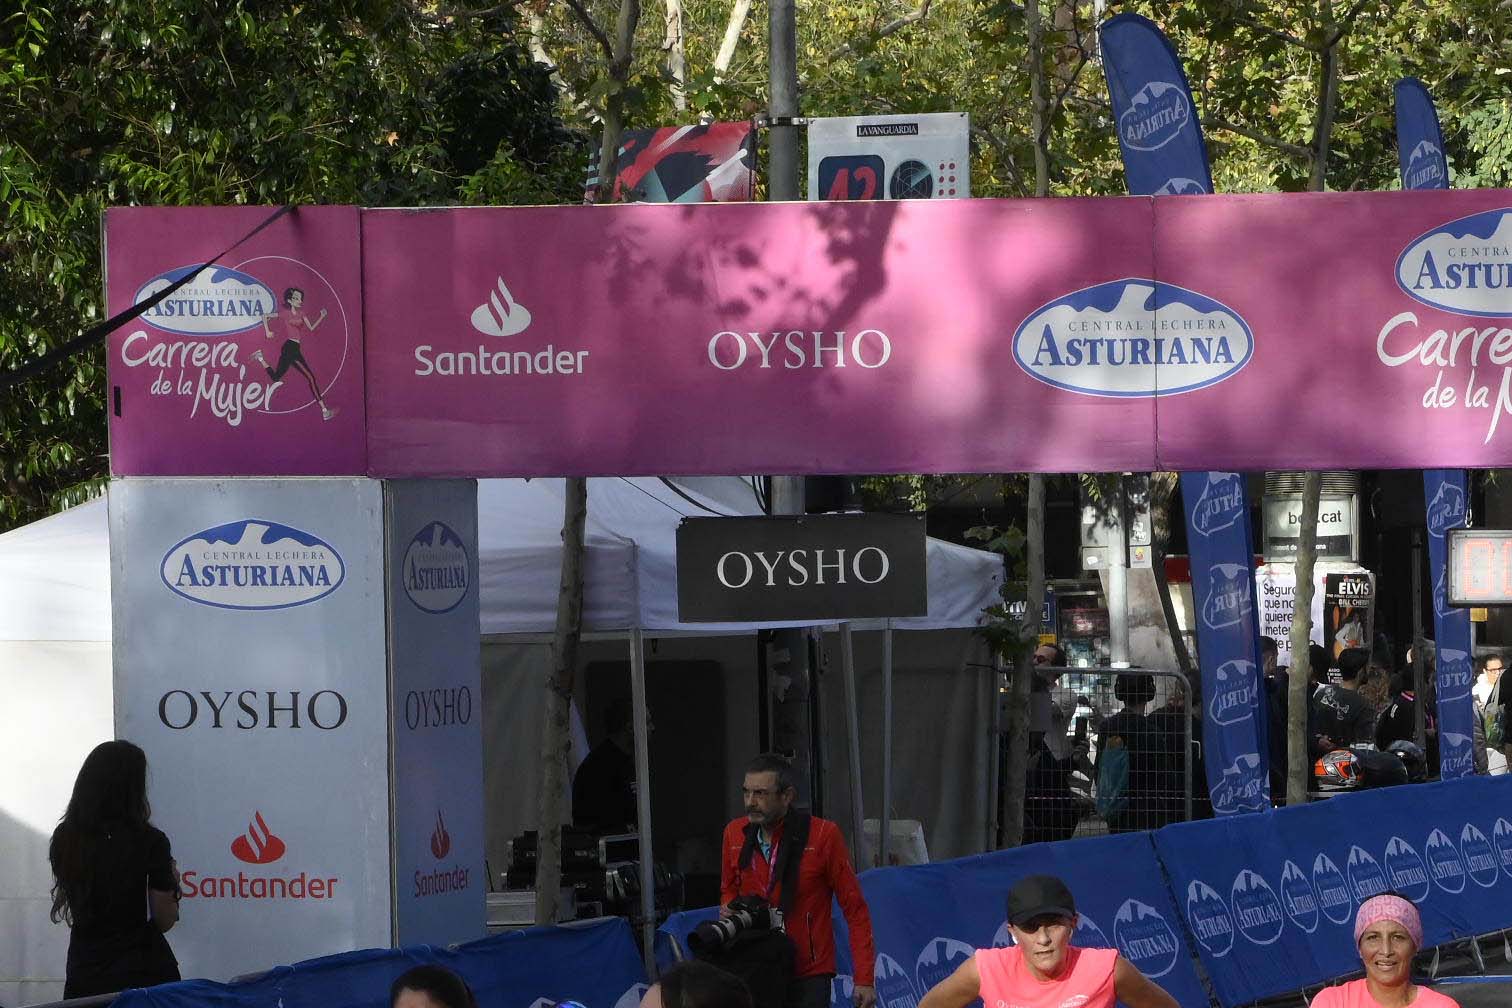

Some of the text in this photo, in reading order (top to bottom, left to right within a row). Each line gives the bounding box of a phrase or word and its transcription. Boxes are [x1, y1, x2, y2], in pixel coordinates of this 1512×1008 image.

[145, 290, 265, 317] ASTURIANA
[1068, 318, 1227, 333] CENTRAL LECHERA
[121, 331, 239, 368] Carrera
[414, 344, 589, 377] Santander
[708, 329, 892, 371] OYSHO
[1031, 324, 1235, 367] ASTURIANA
[150, 364, 284, 427] de la Mujer
[1421, 366, 1457, 411] de
[1464, 368, 1489, 409] la
[175, 553, 332, 588] ASTURIANA
[203, 550, 325, 561] CENTRAL LECHERA
[407, 551, 466, 593] ASTURIANA
[716, 546, 890, 589] OYSHO
[1264, 598, 1281, 609] que
[1338, 582, 1369, 594] ELVIS
[1264, 612, 1294, 624] quiere
[158, 689, 348, 731] OYSHO
[404, 685, 472, 731] OYSHO
[182, 870, 338, 899] Santander
[414, 866, 471, 898] Santander
